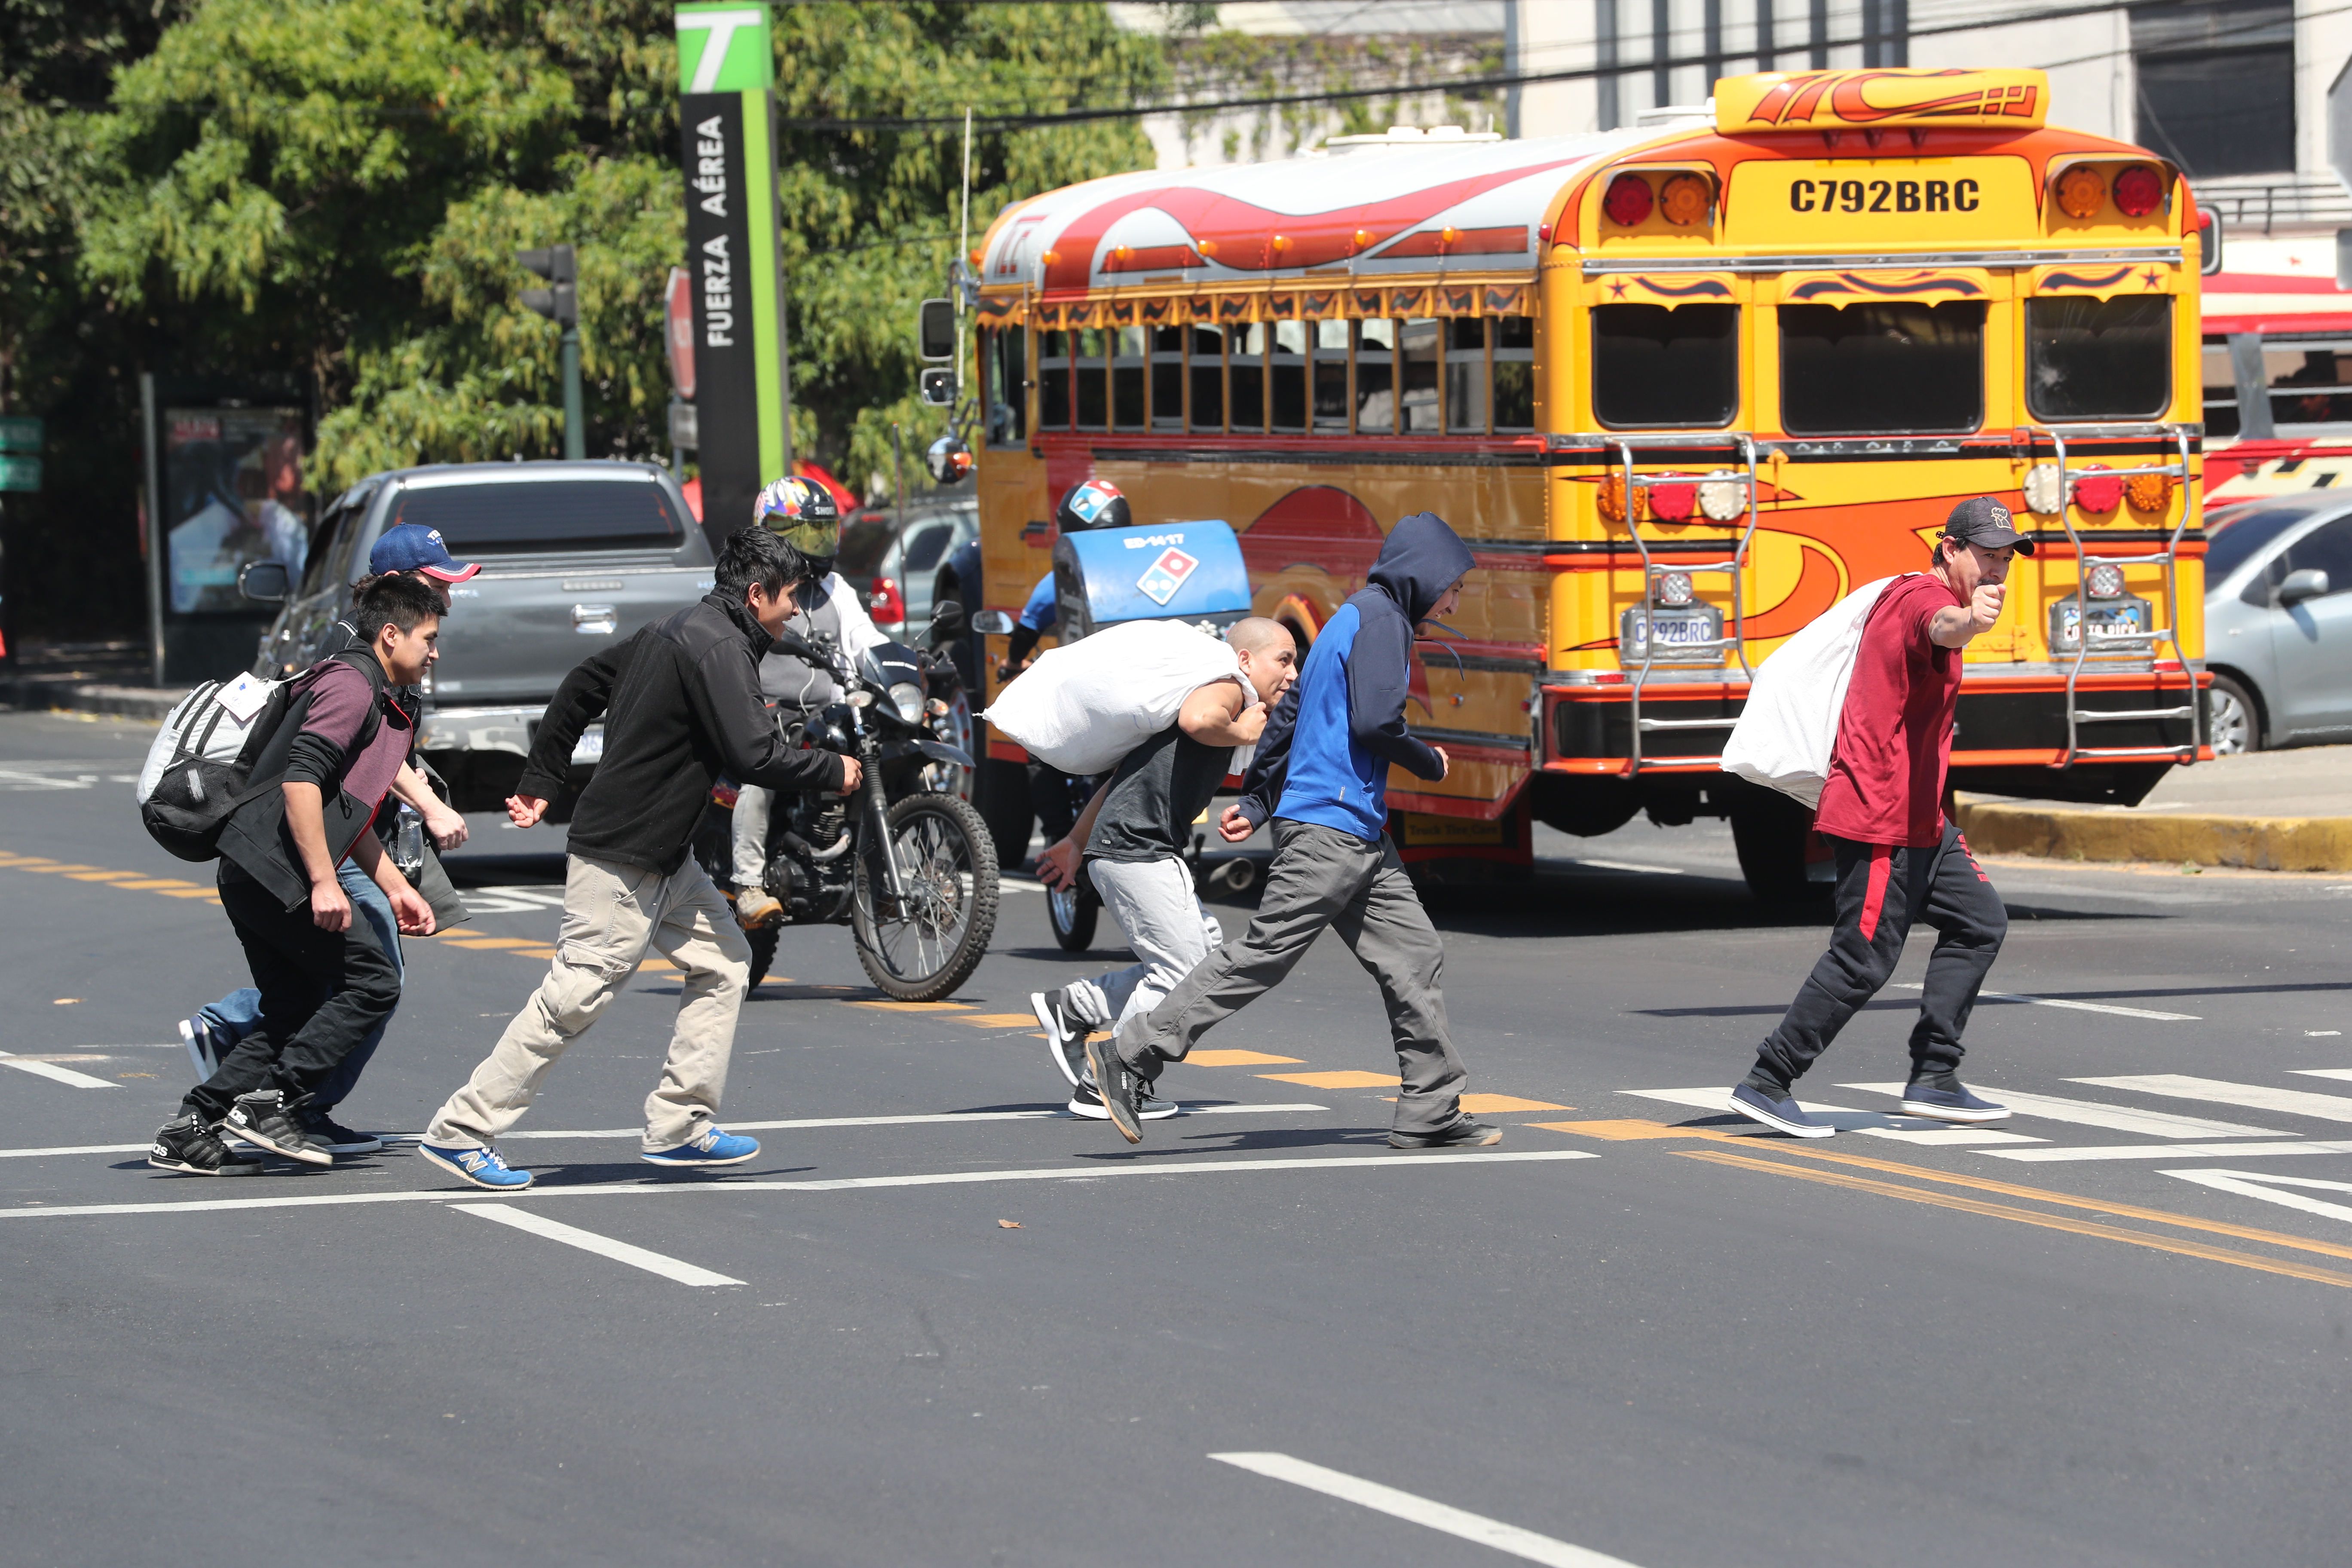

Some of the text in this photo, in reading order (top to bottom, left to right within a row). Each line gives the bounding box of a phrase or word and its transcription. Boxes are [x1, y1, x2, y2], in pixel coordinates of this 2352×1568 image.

[675, 9, 762, 94] T
[1791, 179, 1979, 212] C792BRC
[691, 115, 734, 347] FUERZA AÉREA
[1409, 823, 1498, 835] Truck Tire Care
[458, 1151, 488, 1173] N
